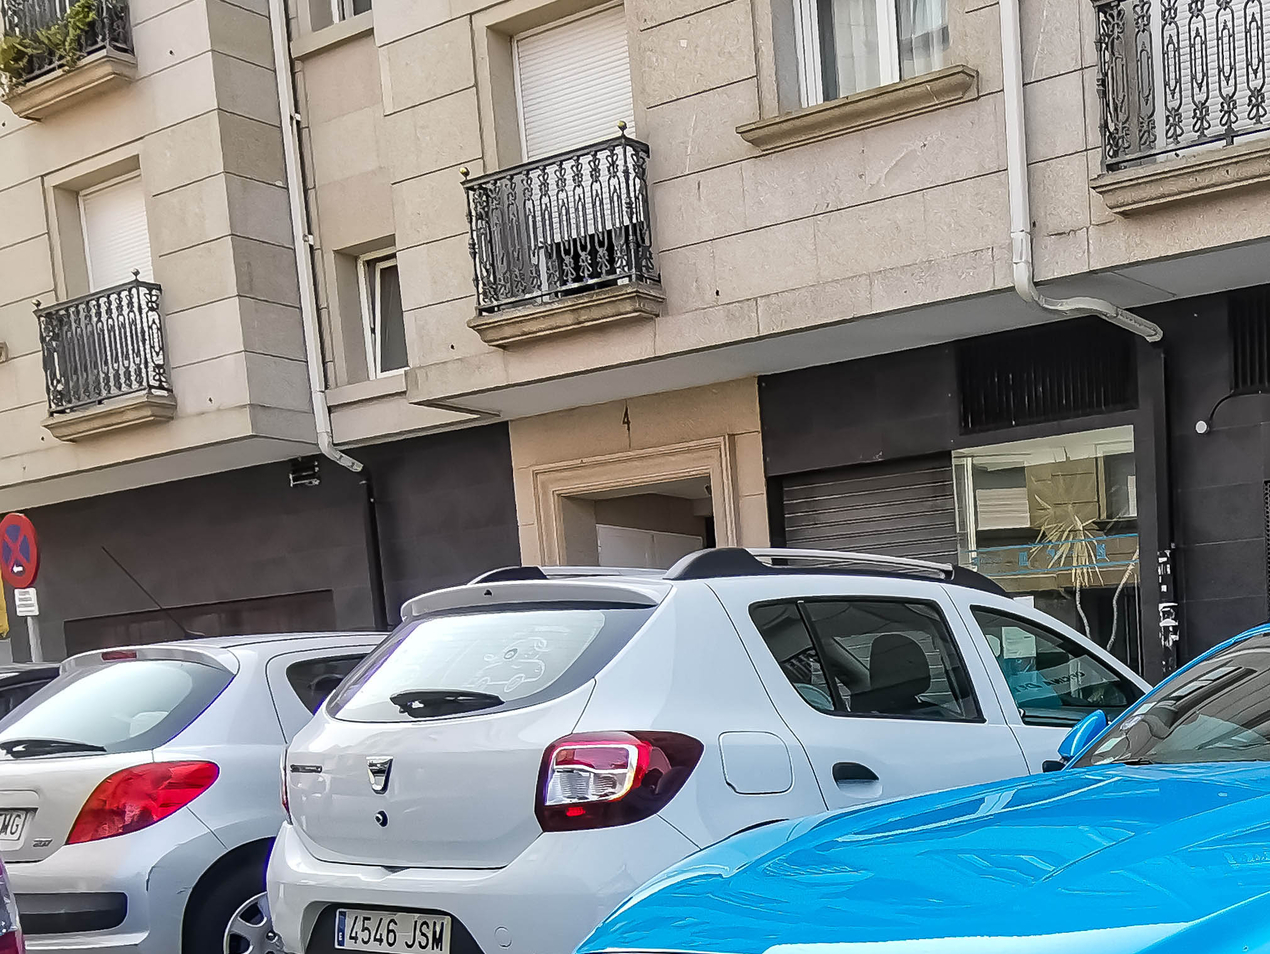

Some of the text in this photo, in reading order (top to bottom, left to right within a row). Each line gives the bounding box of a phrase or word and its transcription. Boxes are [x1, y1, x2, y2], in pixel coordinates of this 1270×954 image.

[622, 404, 631, 431] 4
[0, 813, 21, 835] MG
[348, 915, 398, 947] 4546
[405, 919, 444, 952] JSM
